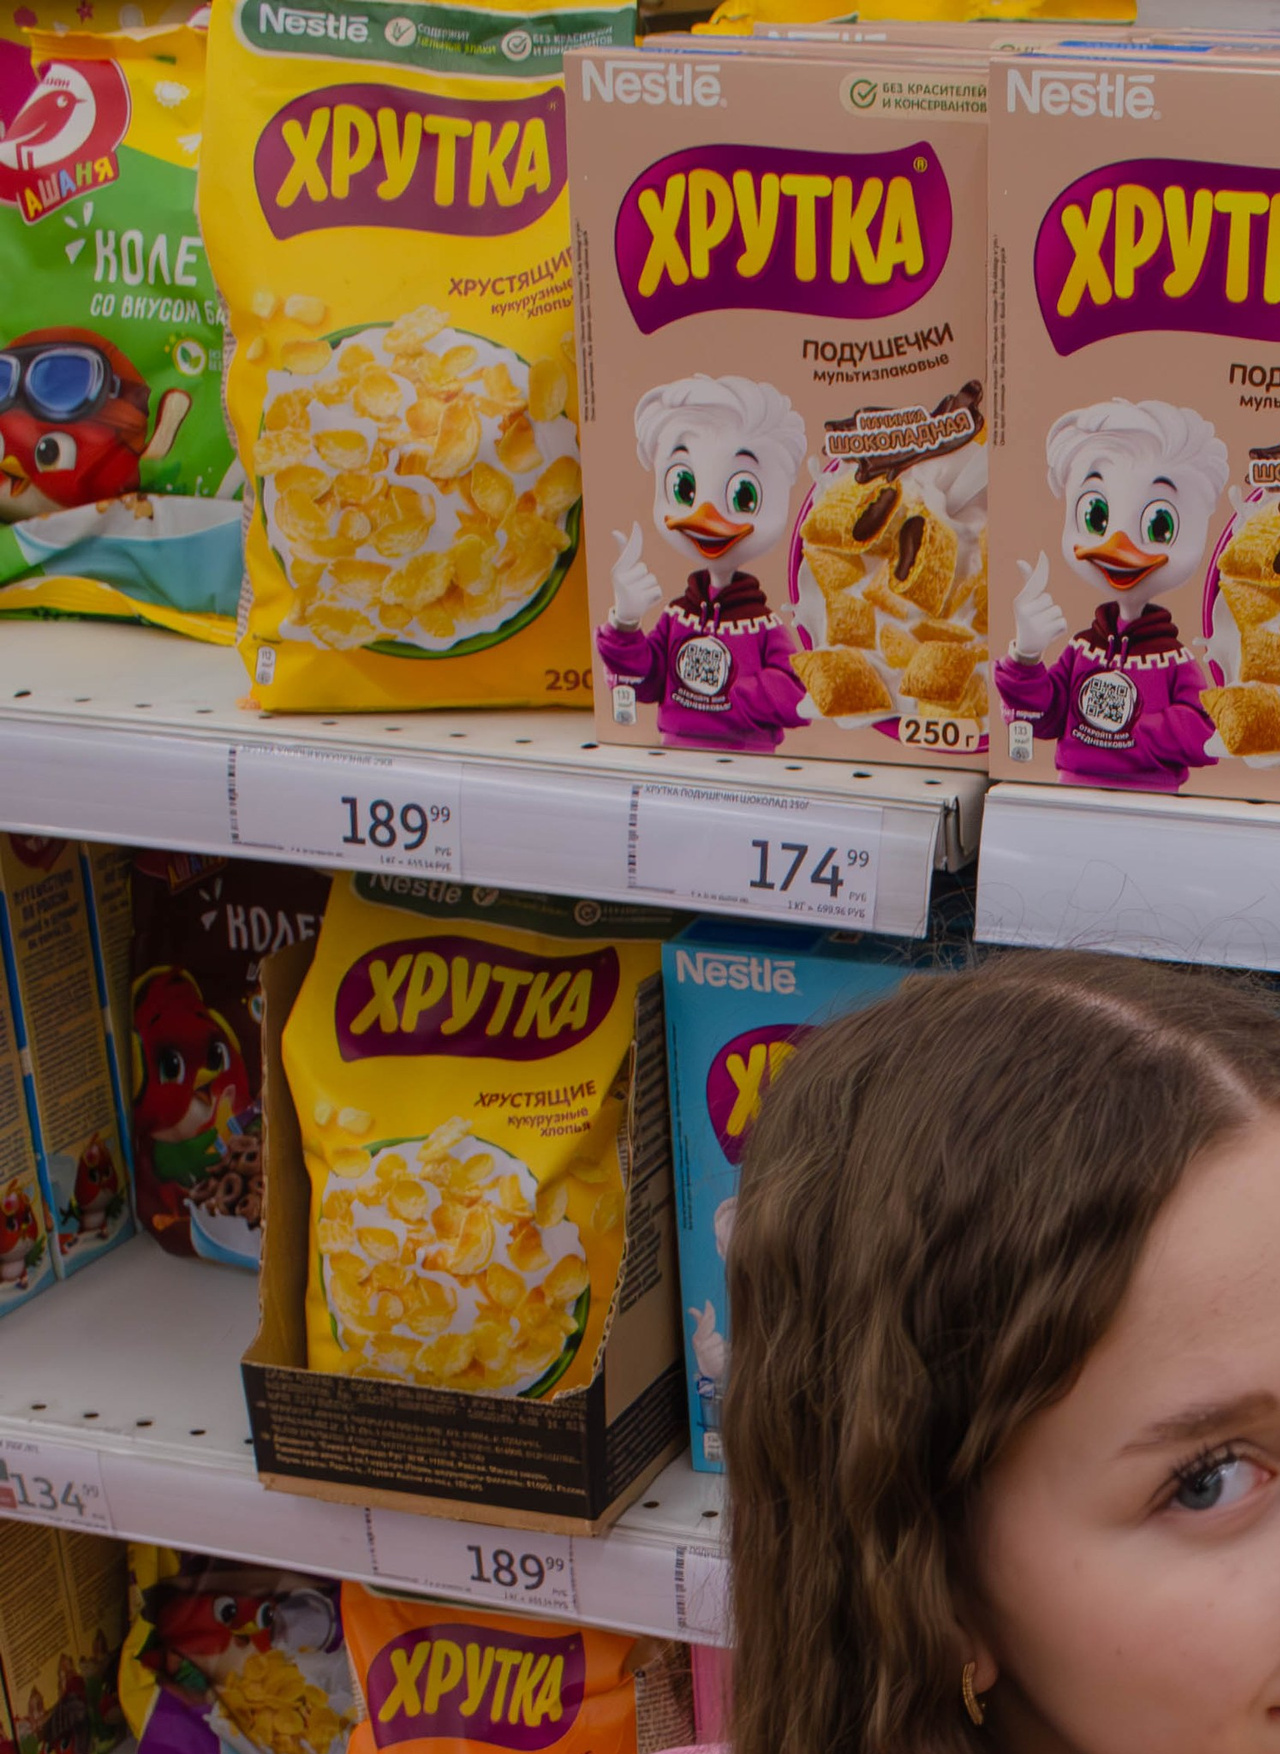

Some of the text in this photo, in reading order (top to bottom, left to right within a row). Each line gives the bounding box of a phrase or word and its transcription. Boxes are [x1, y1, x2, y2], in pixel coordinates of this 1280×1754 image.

[275, 104, 551, 208] ХРУТКА
[638, 168, 924, 297] ХРУТКА
[90, 294, 202, 324] СО ВКУСОМ
[803, 322, 954, 366] ПОДУШЕЧКИ
[829, 412, 971, 454] ШОКОЛАДНАЯ
[904, 720, 960, 746] 250
[341, 796, 450, 851] 189 99
[750, 839, 869, 898] 174 99
[349, 952, 593, 1039] ХРУТКА
[473, 1080, 597, 1110] ХРУСТЯЩИЕ
[10, 1474, 85, 1516] 134
[467, 1545, 565, 1591] 189 99
[378, 1638, 565, 1729] ХРУТКА
